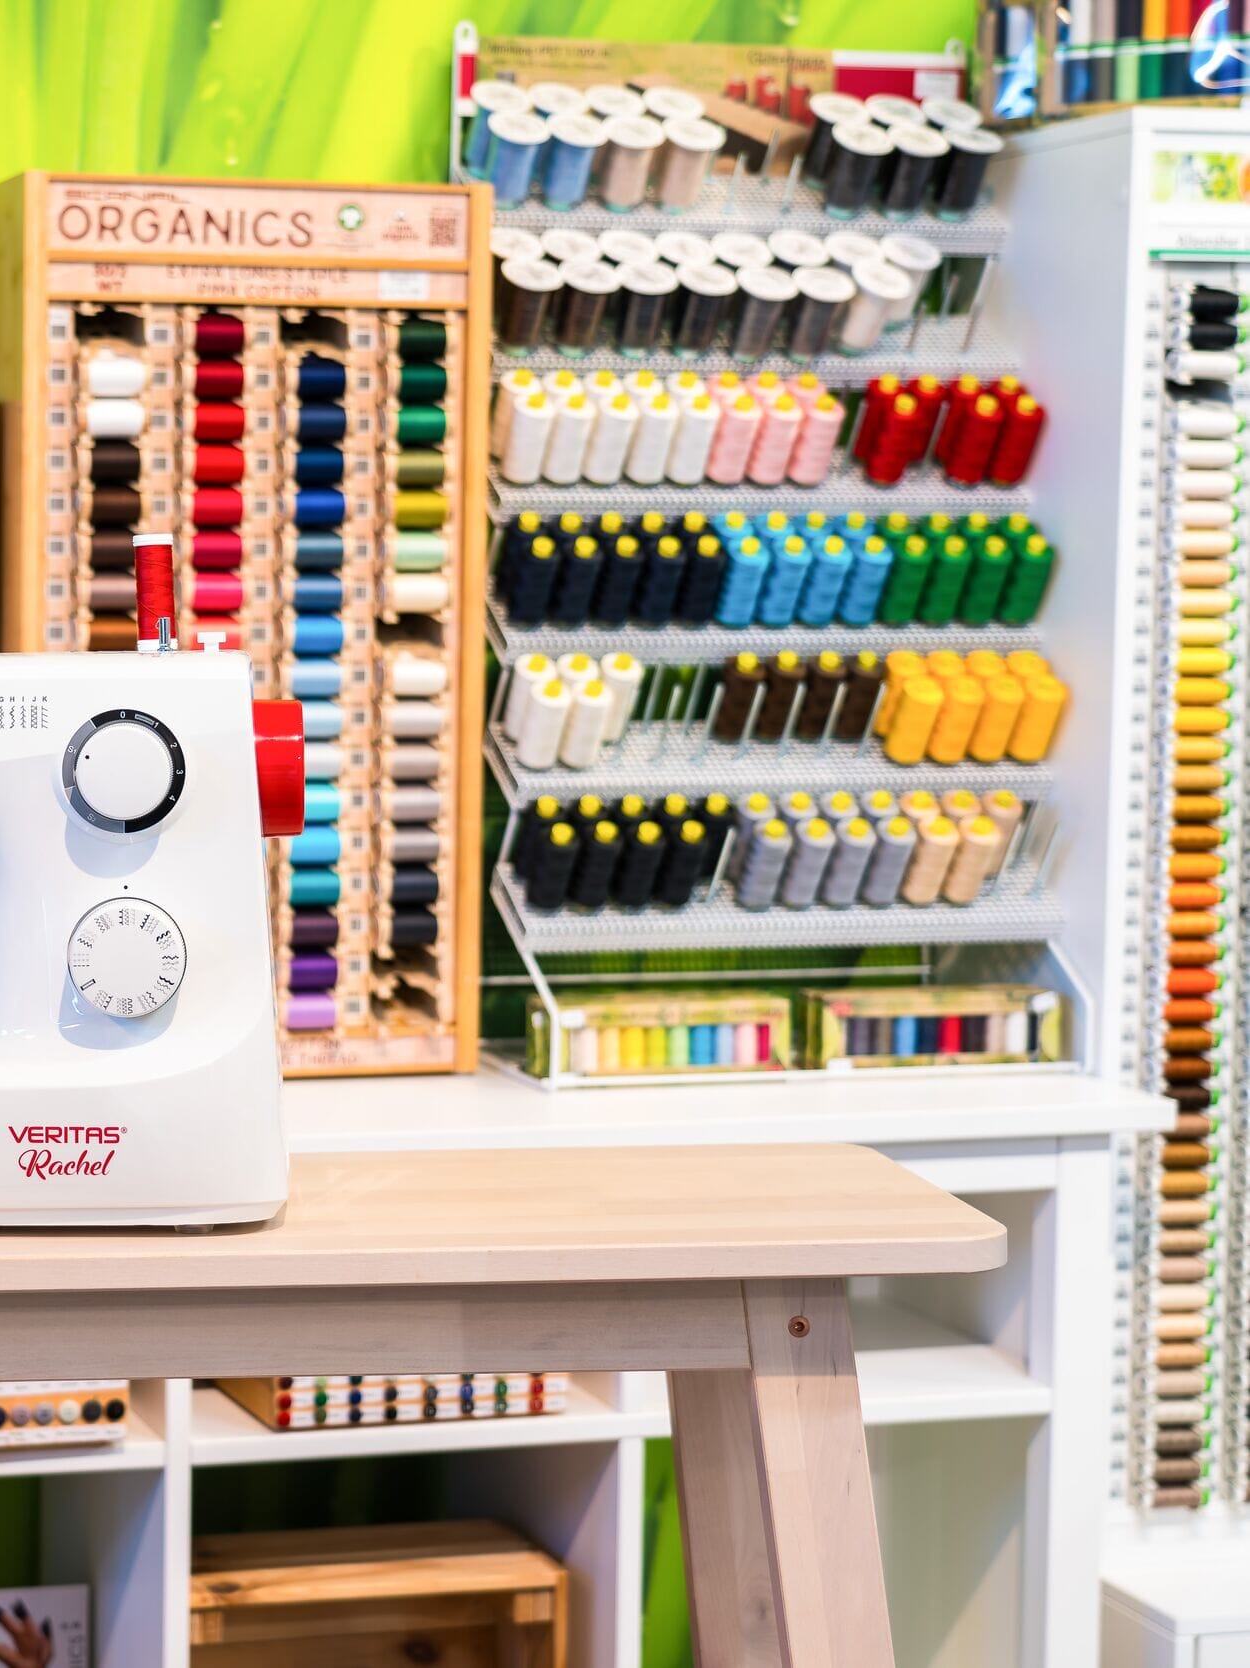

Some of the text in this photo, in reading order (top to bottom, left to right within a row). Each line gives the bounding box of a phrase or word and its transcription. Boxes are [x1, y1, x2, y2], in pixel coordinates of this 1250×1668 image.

[57, 203, 314, 248] ORGANICS
[120, 711, 126, 719] 0
[18, 1149, 116, 1181] Rachel
